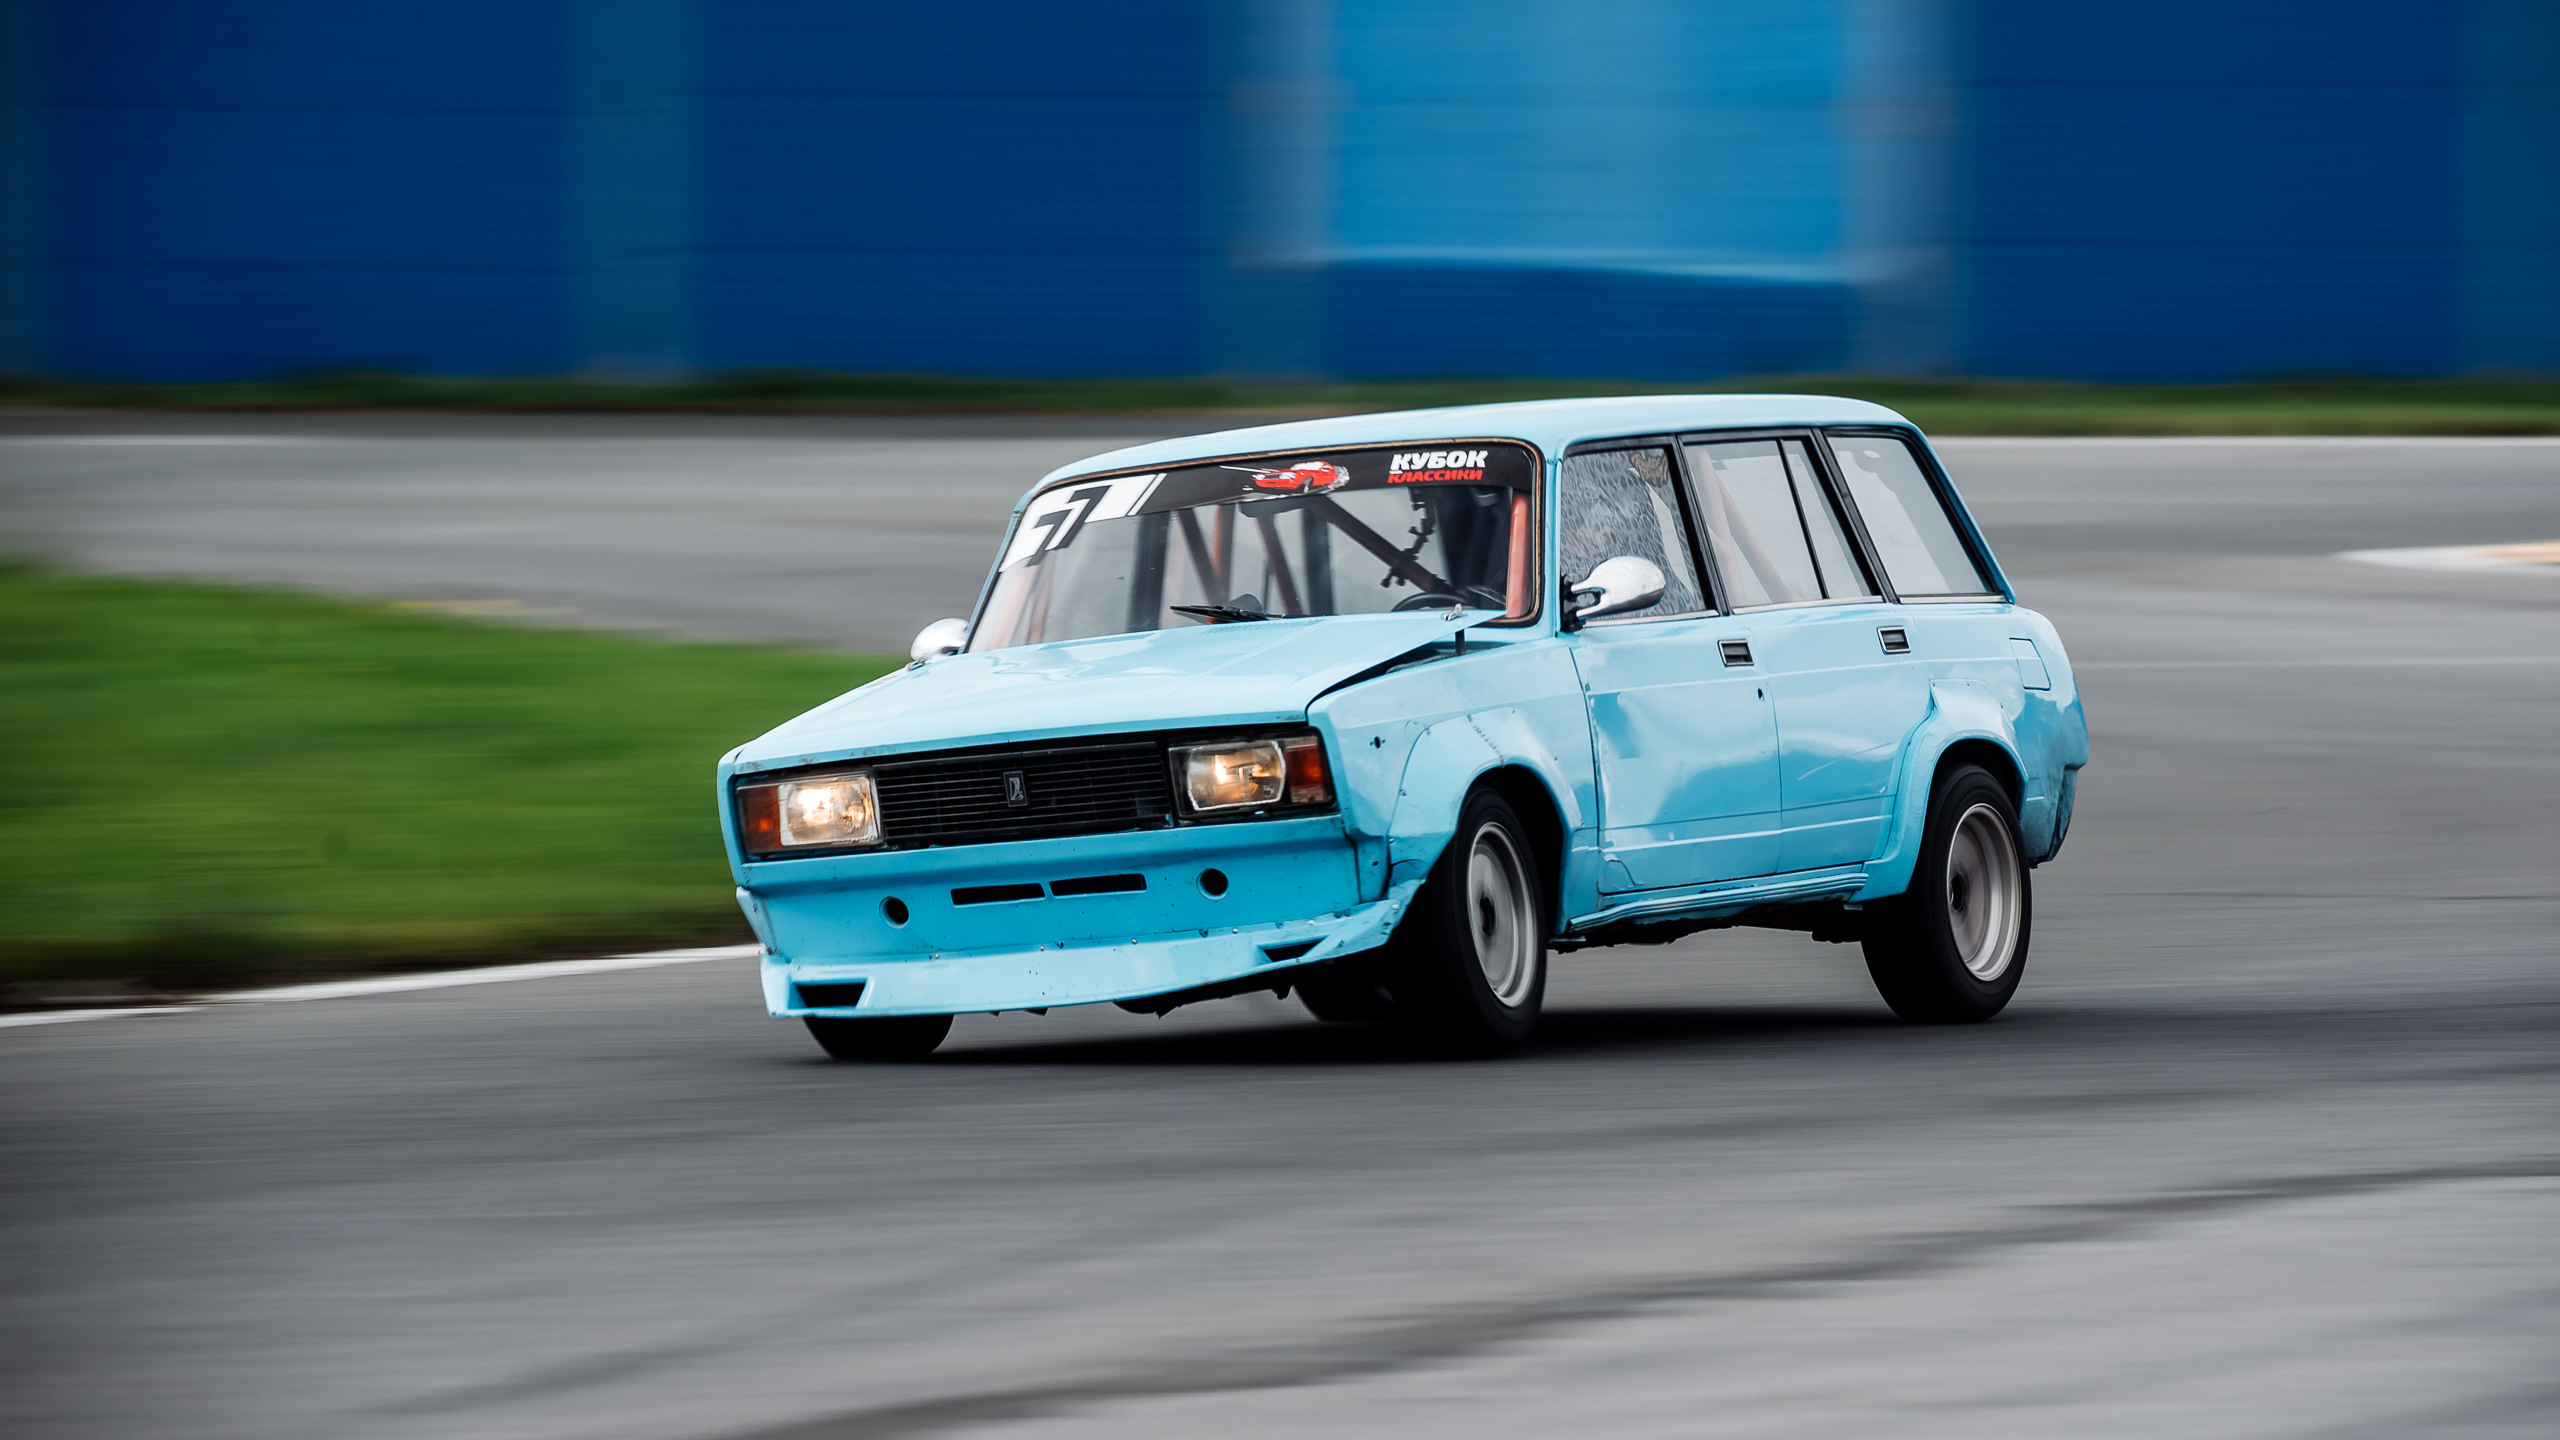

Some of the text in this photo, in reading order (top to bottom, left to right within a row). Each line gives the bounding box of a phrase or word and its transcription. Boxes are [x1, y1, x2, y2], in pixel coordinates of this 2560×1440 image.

[1389, 450, 1489, 472] КУБОК
[1387, 469, 1483, 484] КЛАССИКИ
[1026, 485, 1113, 567] 77
